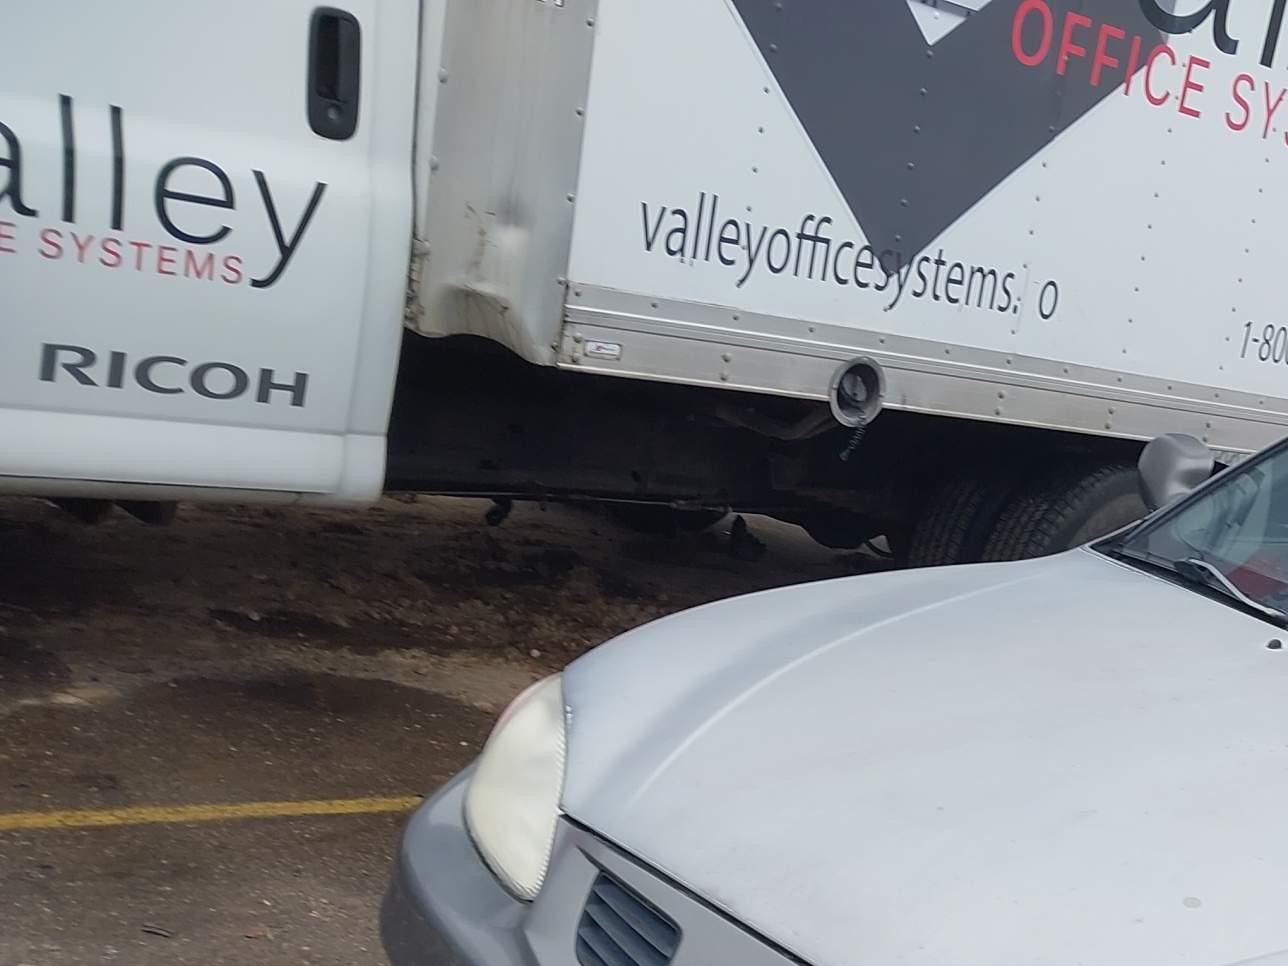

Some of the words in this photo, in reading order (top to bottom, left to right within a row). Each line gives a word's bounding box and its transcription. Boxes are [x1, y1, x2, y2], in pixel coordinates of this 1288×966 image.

[1010, 0, 1211, 119] OFFICE
[38, 228, 243, 285] SYSTEMS
[39, 342, 309, 407] RICOH
